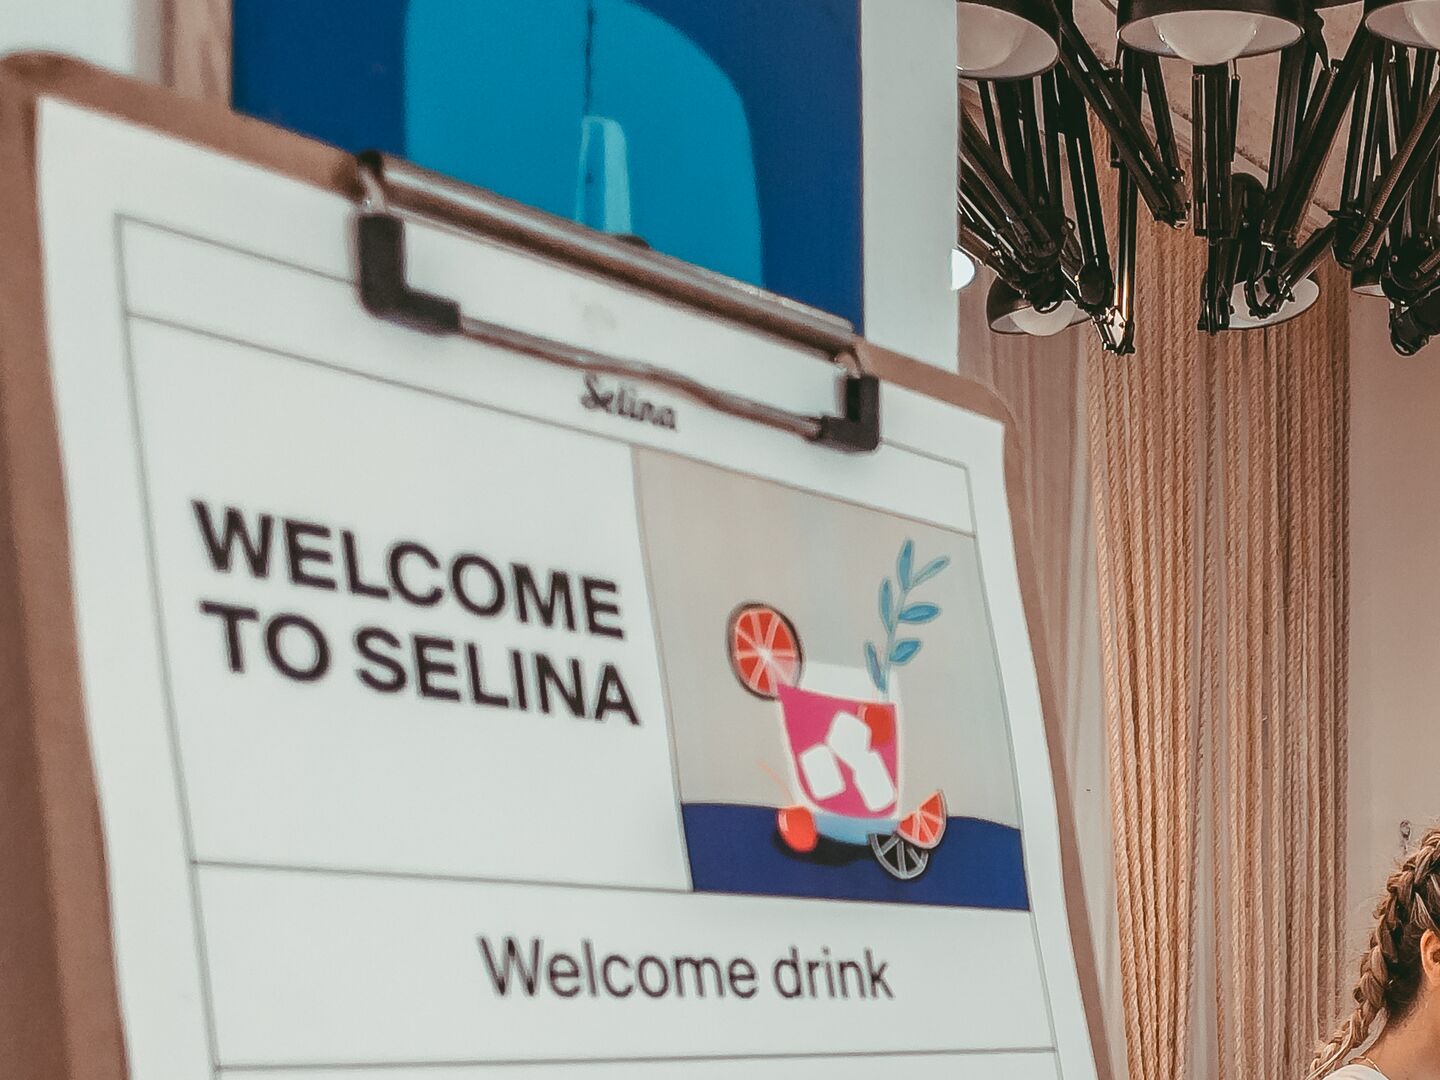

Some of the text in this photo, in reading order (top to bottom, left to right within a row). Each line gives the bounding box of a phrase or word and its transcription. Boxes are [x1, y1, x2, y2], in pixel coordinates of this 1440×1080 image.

[191, 497, 626, 639] WELCOME
[199, 599, 642, 726] TO SELINA
[477, 936, 895, 1001] Welcome drink
